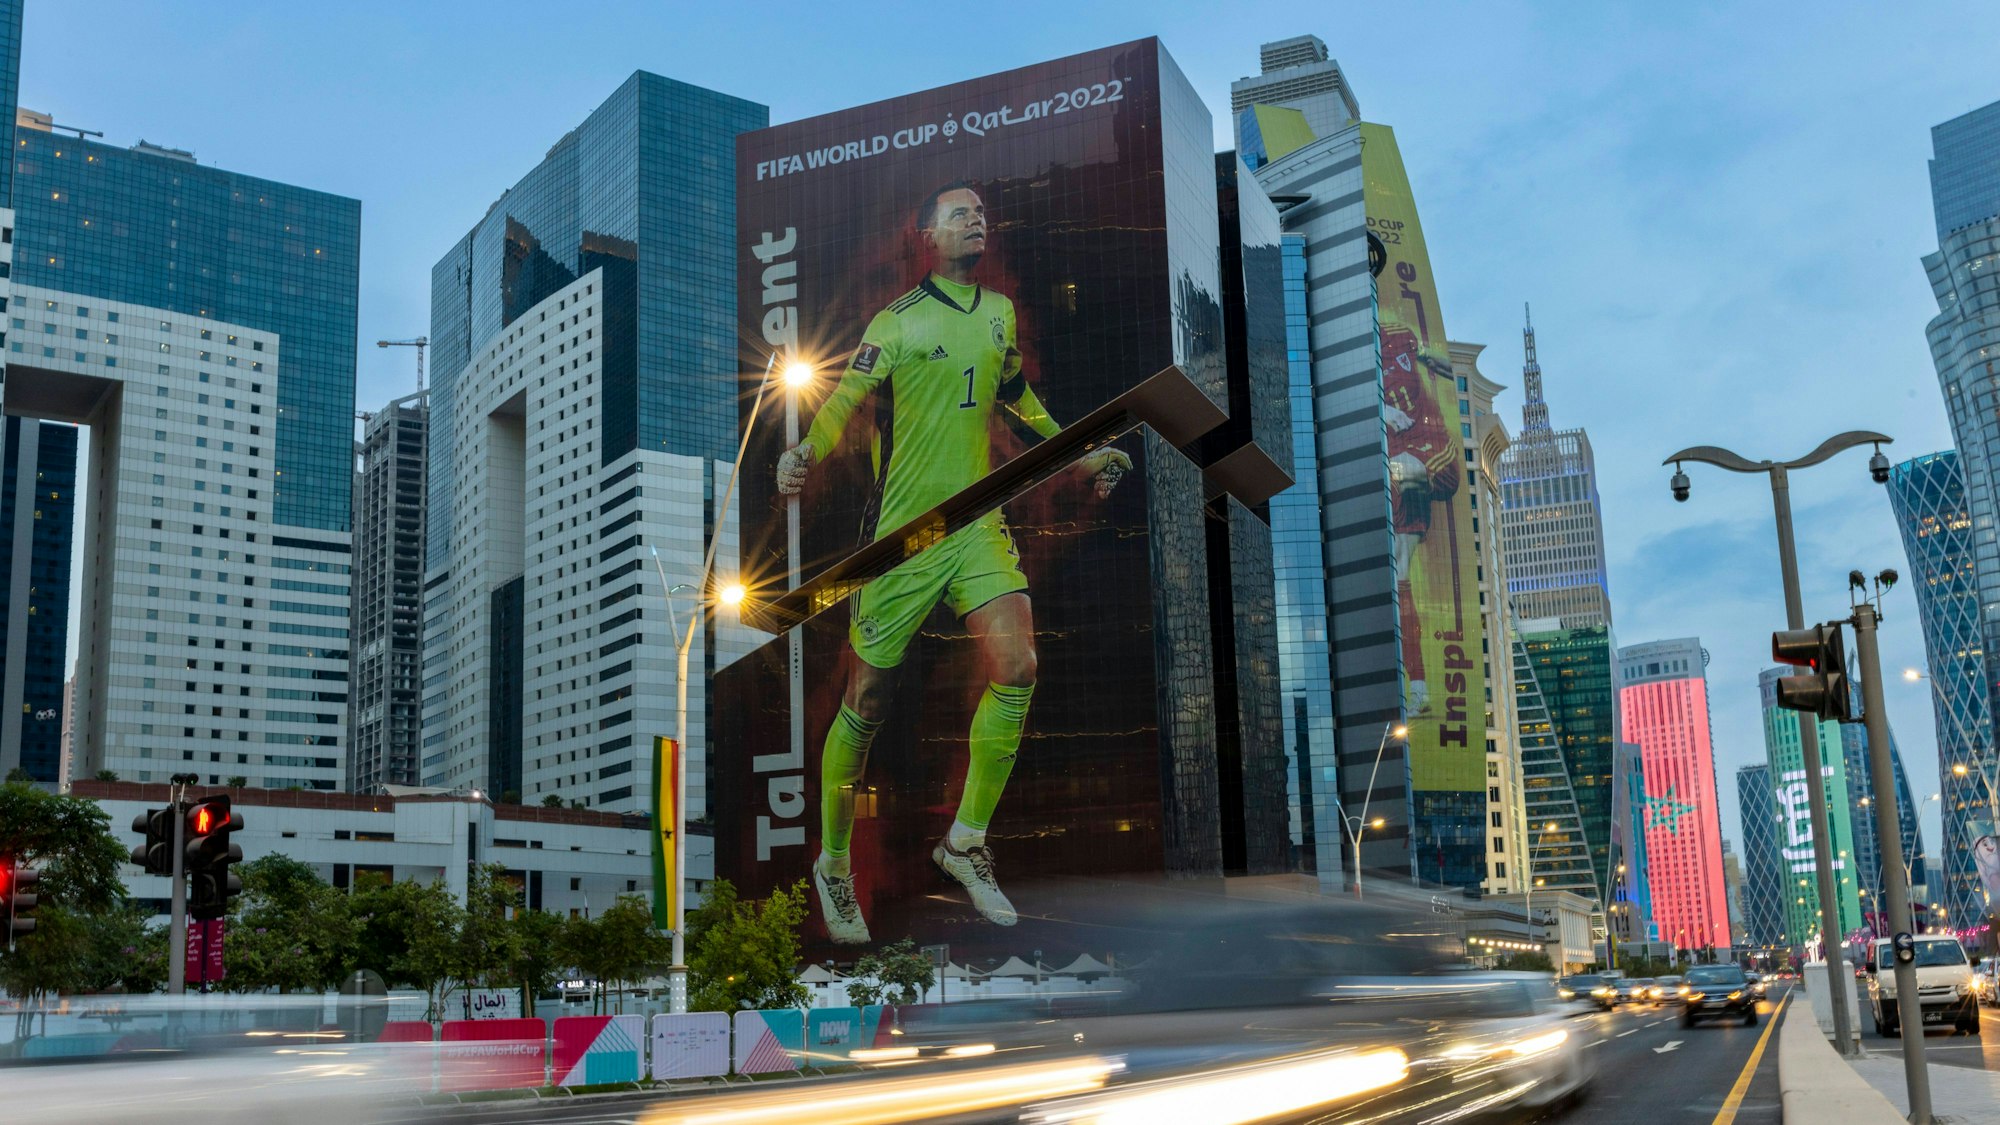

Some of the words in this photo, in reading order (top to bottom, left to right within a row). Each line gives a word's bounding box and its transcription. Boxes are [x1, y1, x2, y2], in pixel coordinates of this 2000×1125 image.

[757, 154, 805, 181] FIFA
[806, 135, 889, 169] WORLD
[893, 123, 938, 150] CUP
[1379, 219, 1405, 231] CUP
[959, 365, 977, 409] 1
